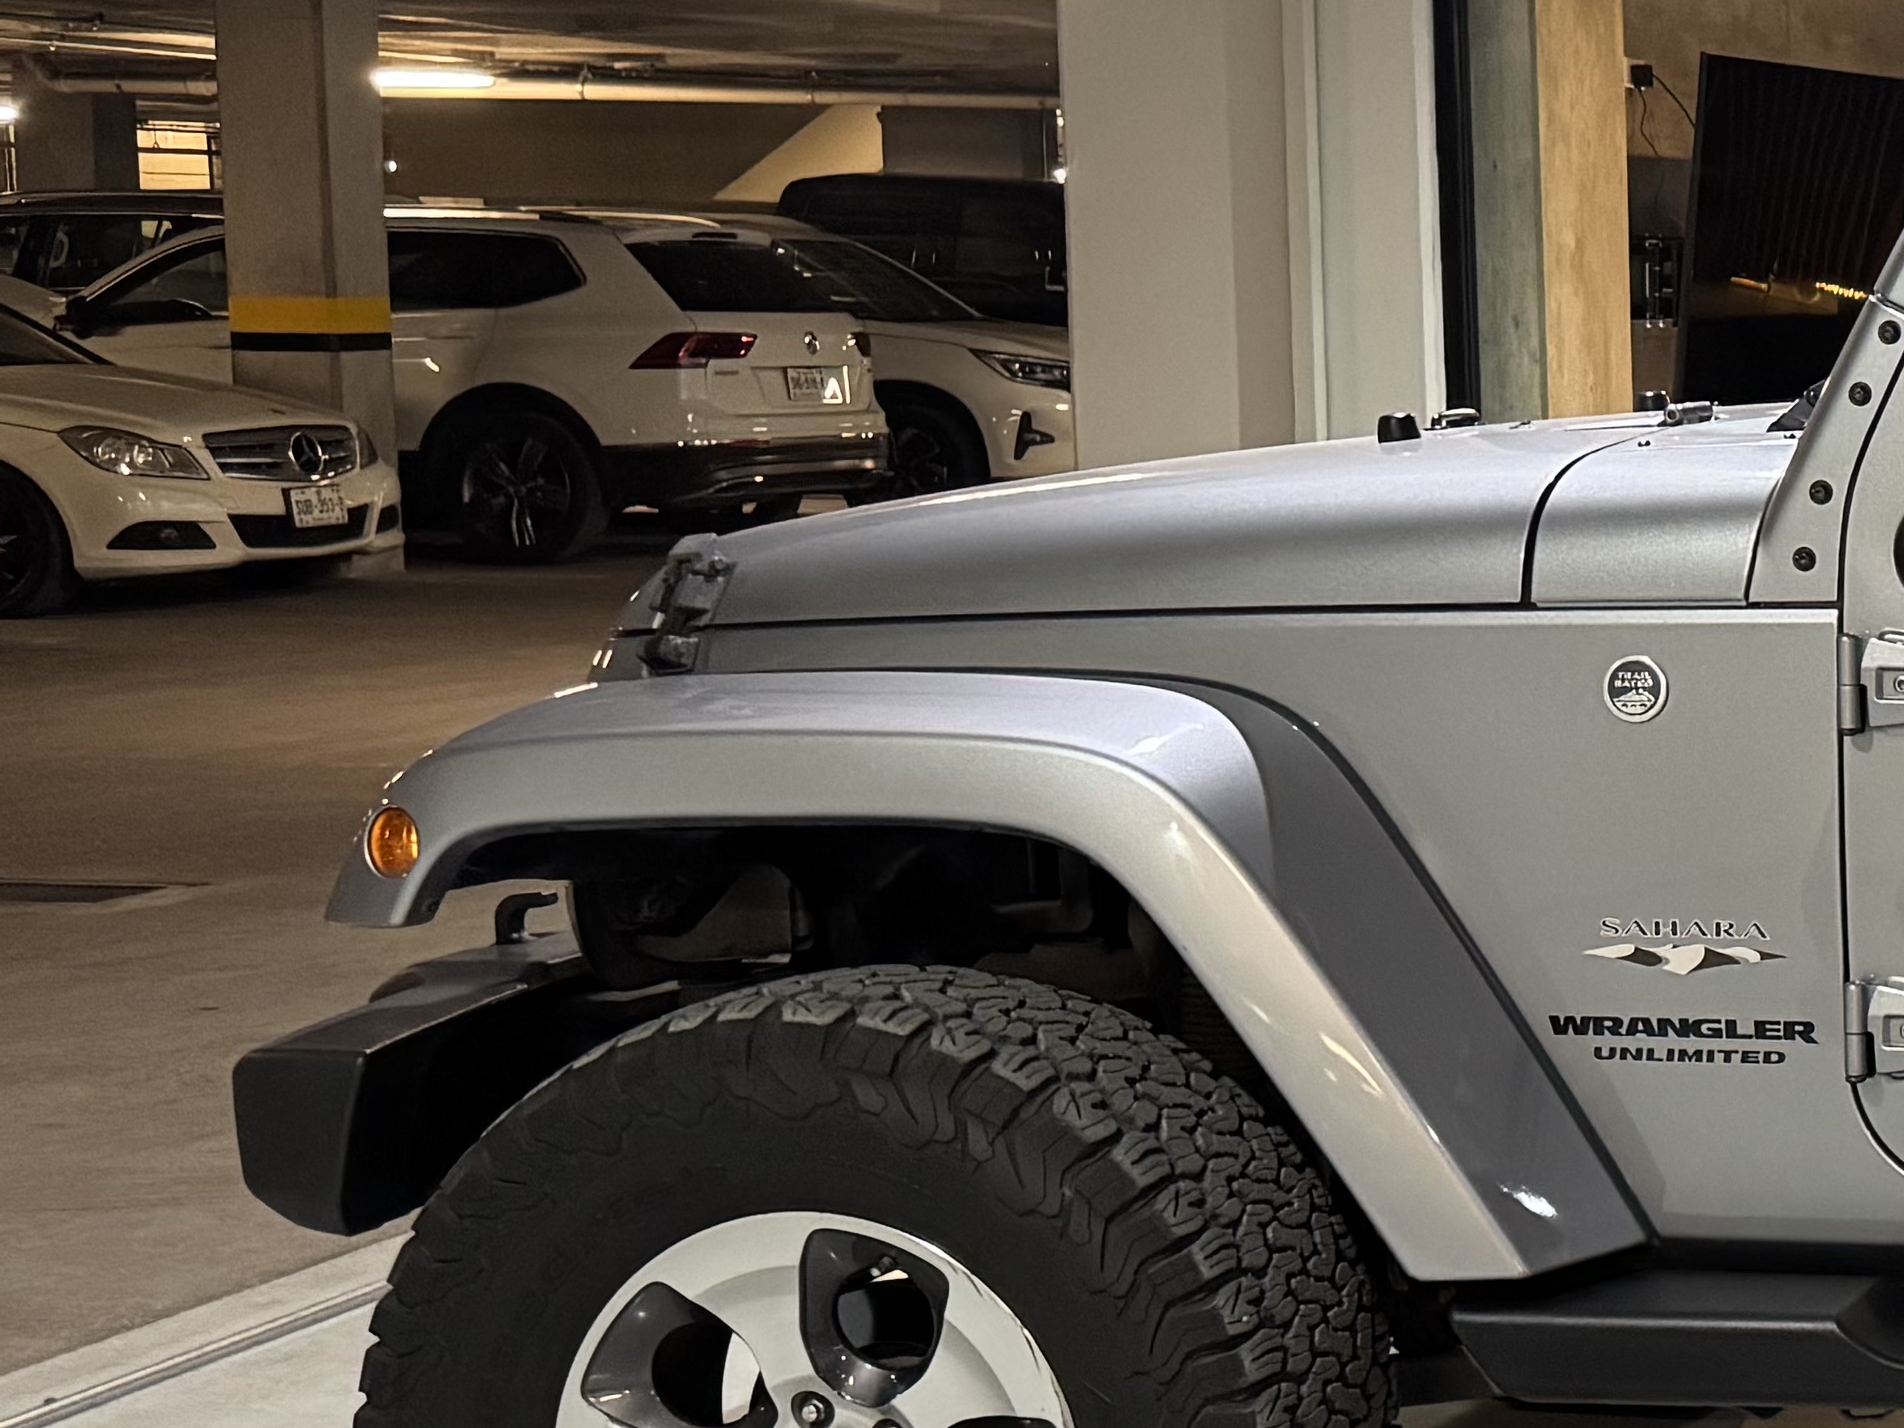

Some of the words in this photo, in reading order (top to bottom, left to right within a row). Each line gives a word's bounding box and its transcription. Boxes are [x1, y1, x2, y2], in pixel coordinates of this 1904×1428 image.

[1613, 679, 1654, 688] RATED
[1618, 671, 1652, 680] TRAIL
[1600, 917, 1771, 940] SAHARA
[1548, 1015, 1819, 1044] WRANGLER
[1593, 1046, 1786, 1064] UNLIMITED
